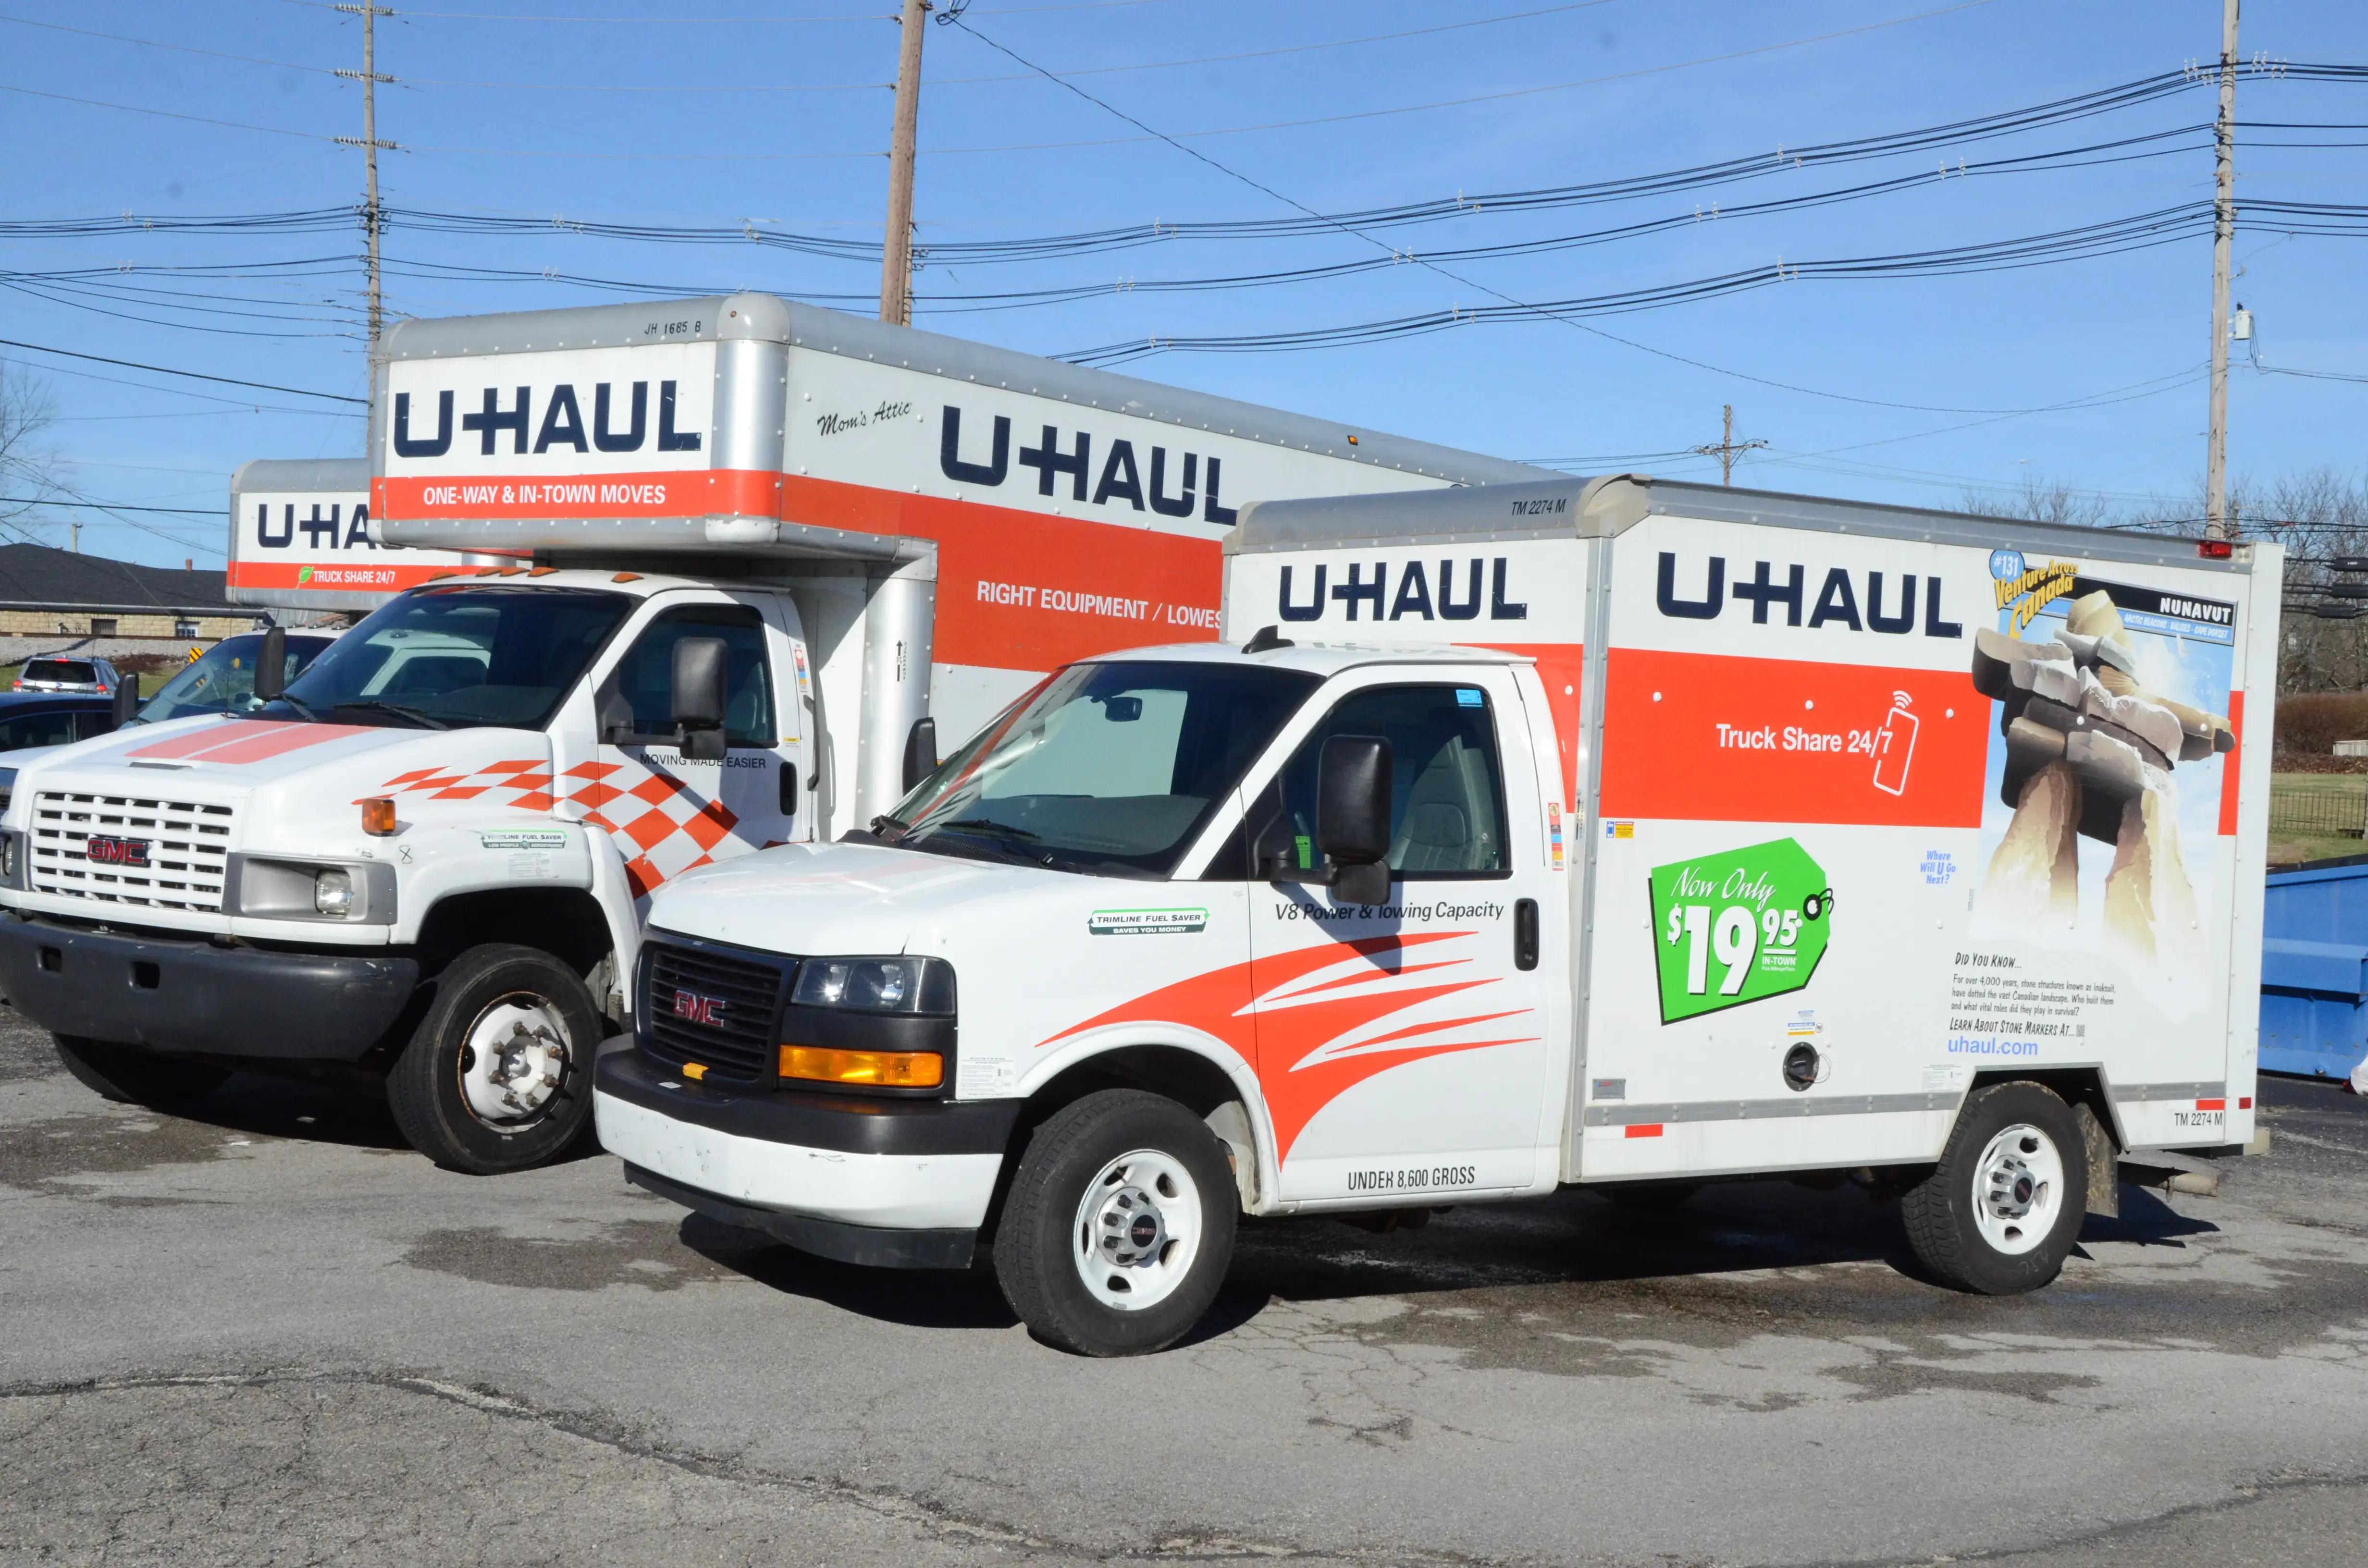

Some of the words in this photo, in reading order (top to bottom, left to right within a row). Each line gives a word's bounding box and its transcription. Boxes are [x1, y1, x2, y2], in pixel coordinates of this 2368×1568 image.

[644, 323, 658, 335] JH
[664, 321, 689, 334] 1685
[694, 320, 702, 333] B
[394, 380, 702, 458] U-HAUL
[817, 410, 867, 436] Mom's
[872, 400, 911, 425] Attic
[940, 405, 1237, 526] U-HAUL
[423, 485, 498, 505] ONE-WAY
[502, 485, 515, 504] &
[519, 484, 596, 504] IN-TOWN
[601, 484, 666, 505] MOVES
[1512, 501, 1527, 515] TM
[1529, 500, 1553, 514] 2274
[1555, 498, 1566, 513] M
[1994, 555, 2018, 576] #131
[313, 570, 342, 583] TRUCK
[345, 570, 374, 584] SHARE
[376, 570, 395, 584] 24/7
[1994, 567, 2047, 612] Venture
[2048, 559, 2079, 577] Across
[1279, 557, 1528, 622] U-HAUL
[1656, 552, 1962, 639] U-HAUL
[977, 581, 1036, 607] RIGHT
[1041, 588, 1148, 620] EQUIPMENT
[2008, 574, 2074, 640] Canada
[2160, 598, 2231, 623] NUNAVUT
[1716, 723, 1776, 749] Truck
[1782, 726, 1842, 752] Share
[1847, 726, 1893, 758] 24/7
[640, 754, 687, 766] MOVING
[727, 757, 766, 769] EASIER
[86, 838, 145, 864] GMC
[1927, 850, 1951, 860] Where
[1920, 862, 1936, 872] Will
[1937, 862, 1944, 875] U
[1946, 863, 1956, 873] Go
[1670, 867, 1719, 898] Now
[1722, 868, 1776, 913] Only
[1276, 903, 1299, 920] V8
[1303, 903, 1353, 920] Power
[1358, 904, 1372, 919] &
[1436, 901, 1505, 921] Capacity
[1762, 956, 1796, 965] IN-TOWN
[1953, 974, 1963, 984] For
[1980, 976, 2000, 986] 4,000
[2002, 980, 2019, 988] years,
[2021, 979, 2036, 988] stone
[2038, 980, 2065, 990] structures
[2066, 980, 2084, 991] known
[1952, 987, 1966, 997] have
[1967, 988, 1986, 998] dotted
[1988, 989, 1997, 999] the
[1999, 991, 2010, 999] vast
[2012, 991, 2039, 1001] Canadian
[2041, 992, 2069, 1004] landscape.
[2072, 994, 2084, 1004] Who
[2100, 995, 2114, 1005] them
[673, 989, 726, 1028] GMC
[1951, 1000, 1961, 1010] and
[1963, 1001, 1977, 1011] what
[1980, 1002, 1992, 1012] vital
[1994, 1003, 2007, 1013] roles
[2009, 1004, 2018, 1013] did
[2020, 1004, 2032, 1016] they
[2034, 1005, 2046, 1016] play
[2047, 1006, 2053, 1015] in
[2055, 1007, 2080, 1016] survival?
[1948, 1036, 2038, 1055] uhaul.com
[2174, 1113, 2188, 1126] TM
[2191, 1112, 2211, 1126] 2274
[2214, 1112, 2222, 1125] M
[1348, 1171, 1394, 1190] UNDER
[1397, 1169, 1429, 1189] 8,600
[1432, 1166, 1475, 1186] GROSS
